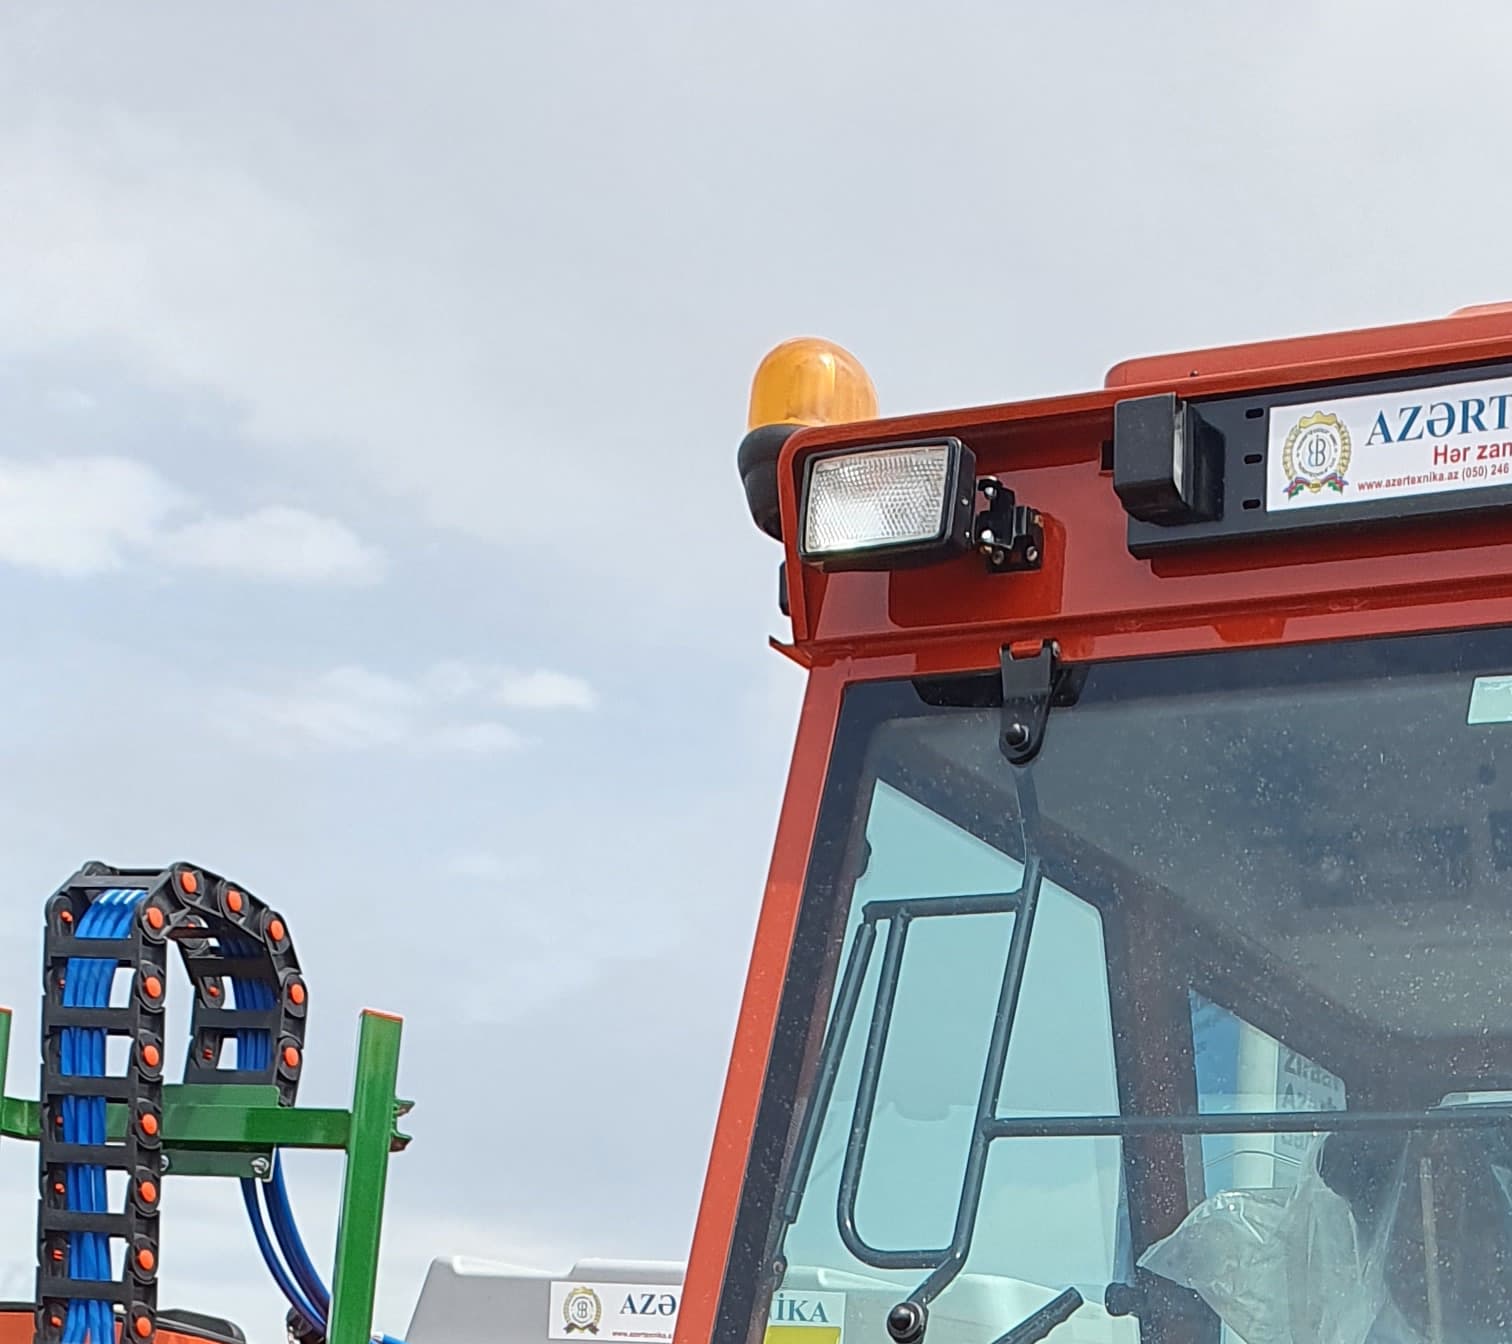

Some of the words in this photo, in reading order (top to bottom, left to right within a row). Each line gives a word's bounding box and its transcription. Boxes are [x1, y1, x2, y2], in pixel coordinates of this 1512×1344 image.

[1433, 444, 1471, 466] Hər
[1462, 464, 1488, 482] (050)
[1491, 463, 1509, 476] 246
[618, 1292, 678, 1316] AZƏ
